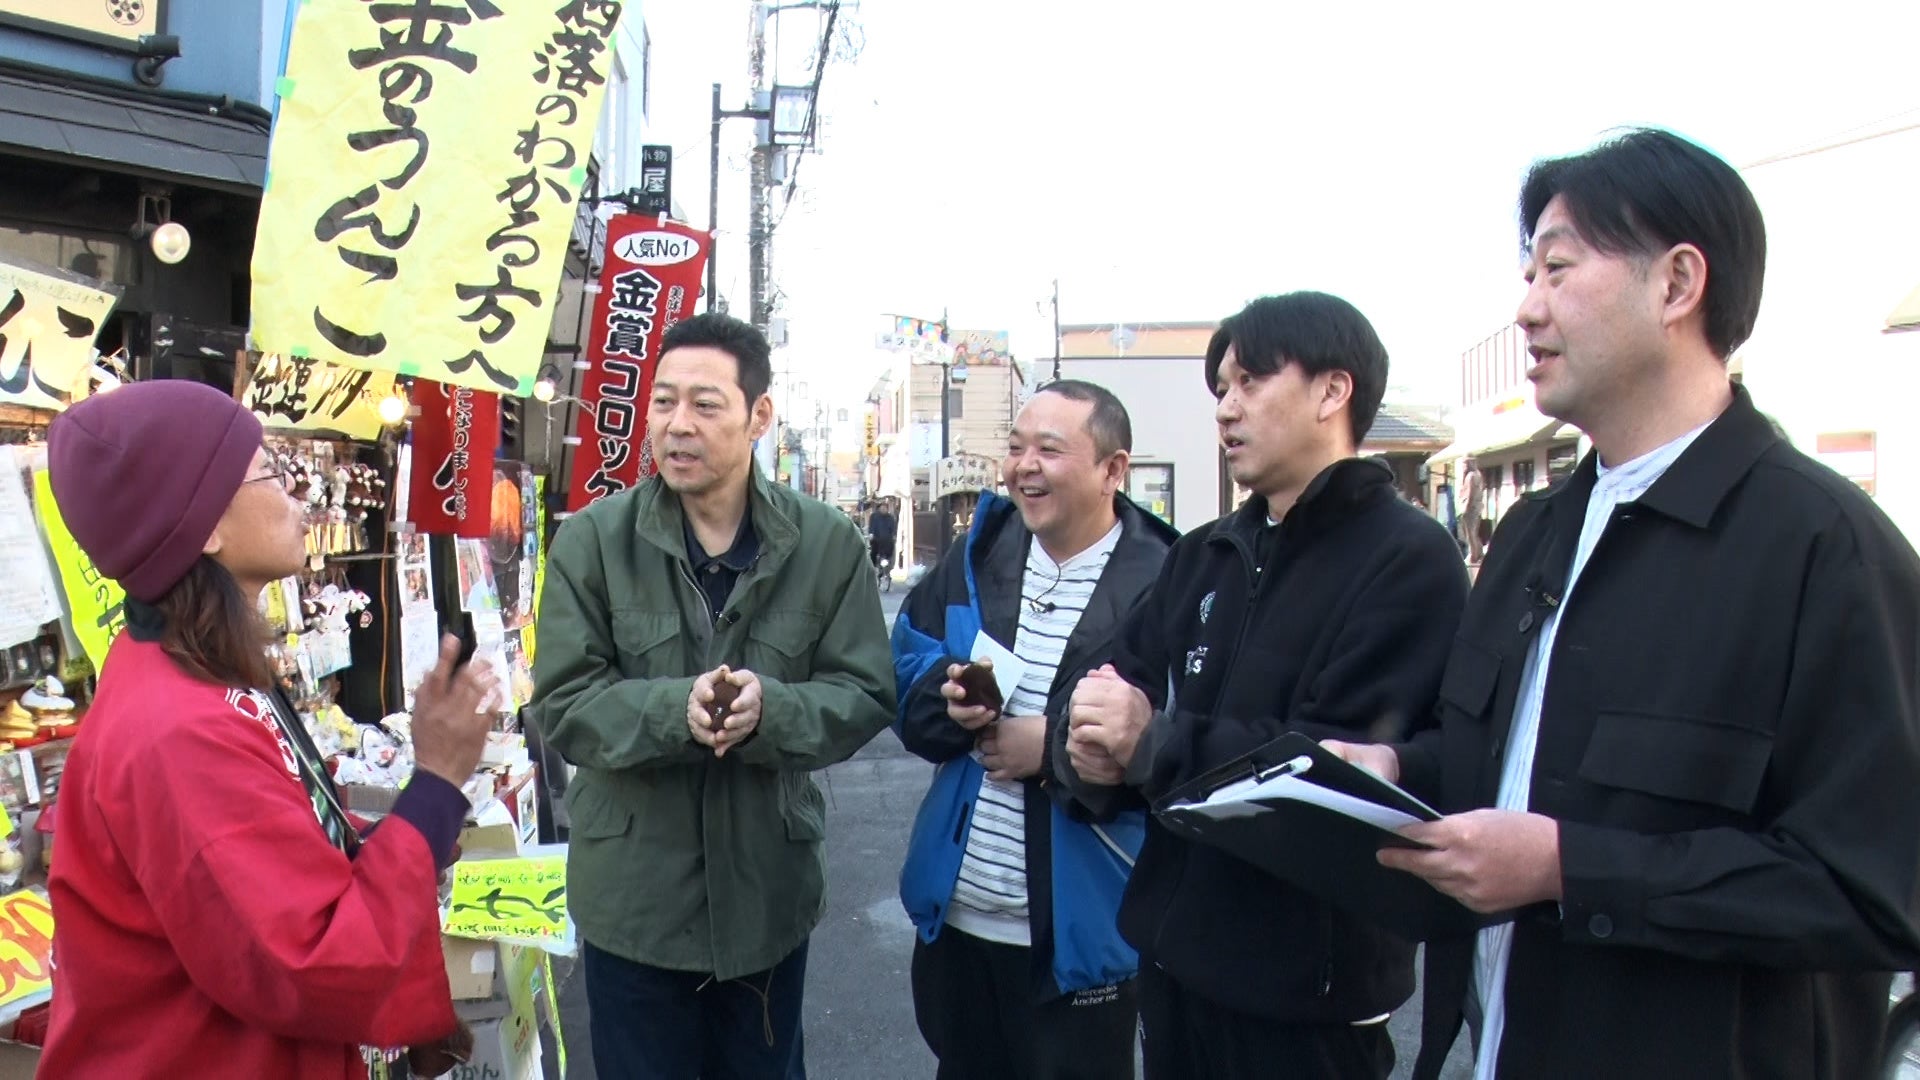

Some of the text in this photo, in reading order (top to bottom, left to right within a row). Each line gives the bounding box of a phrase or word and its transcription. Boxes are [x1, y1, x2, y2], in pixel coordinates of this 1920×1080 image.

[643, 167, 667, 192] 屋
[623, 238, 690, 259] 人気No1
[585, 268, 661, 504] 金賞コロッケ
